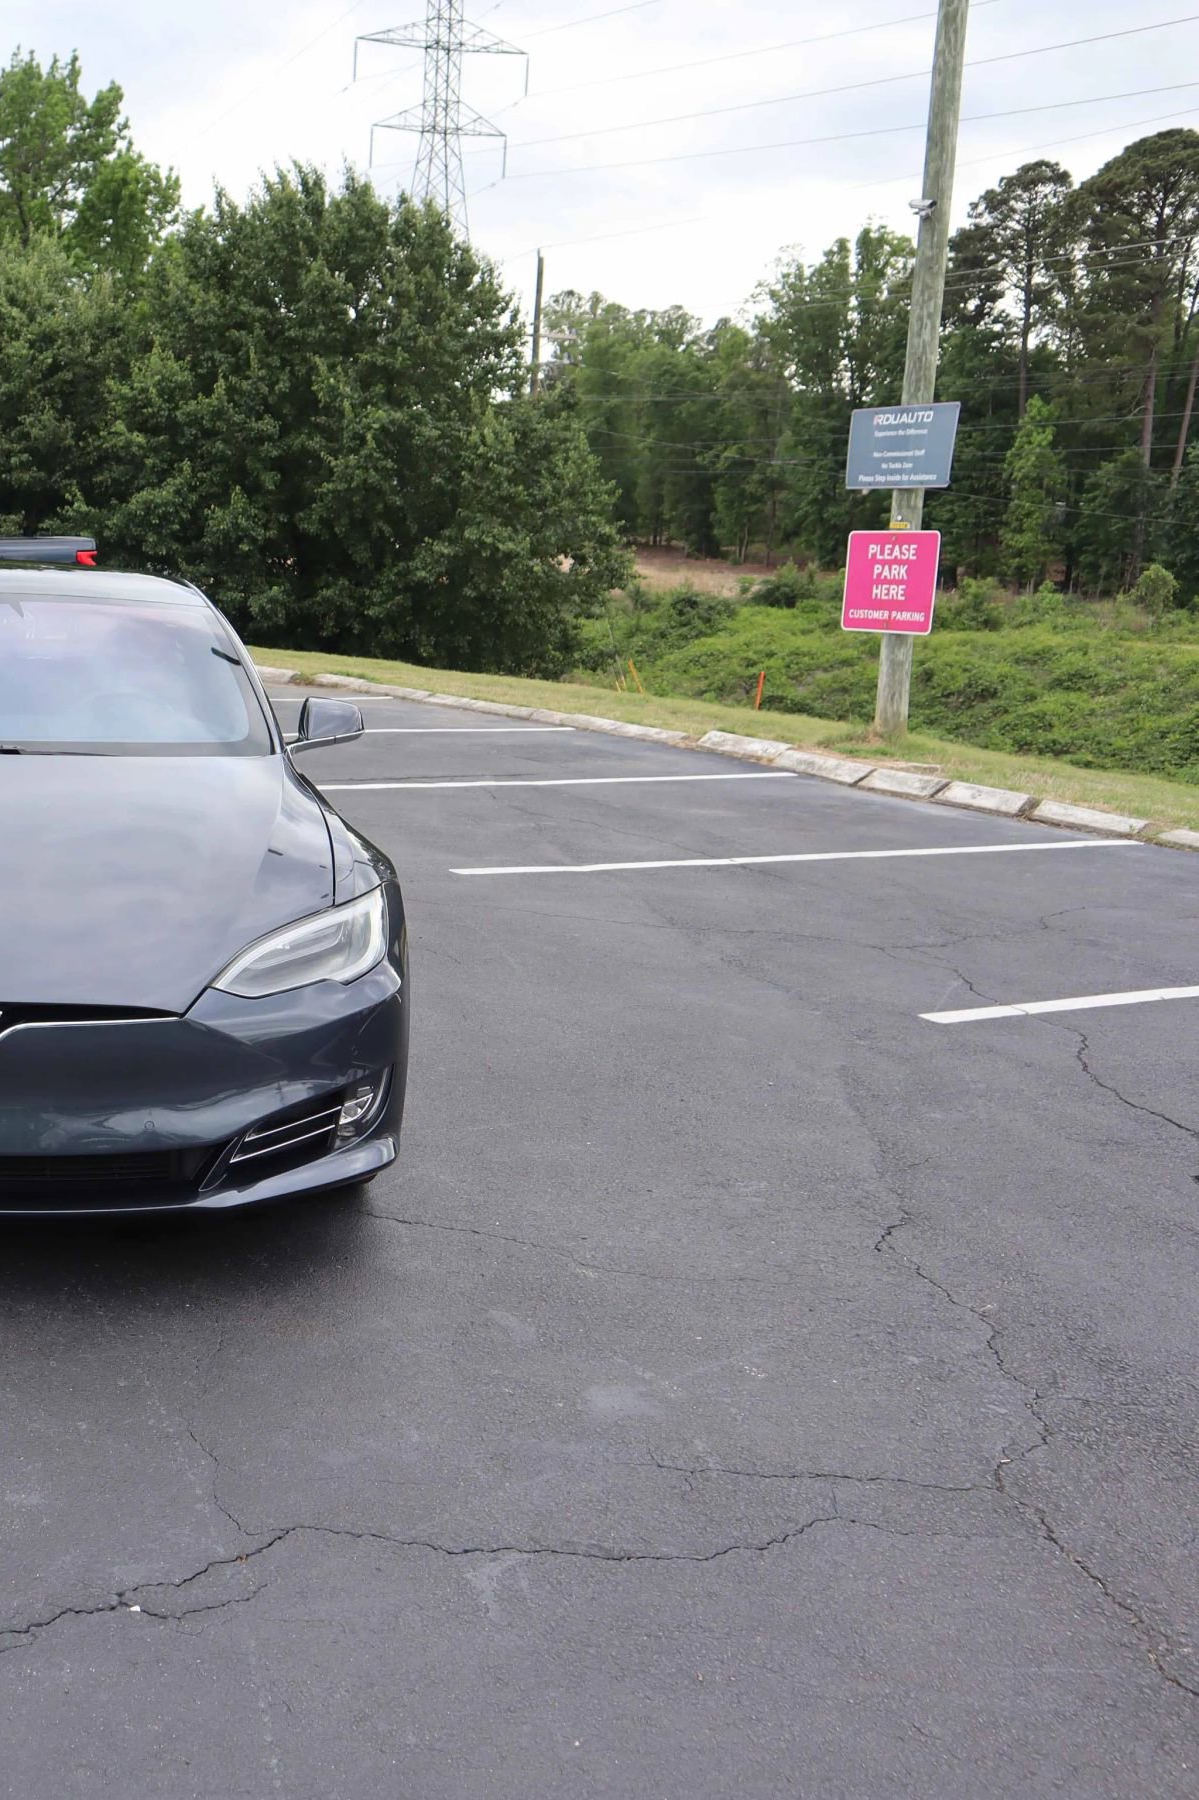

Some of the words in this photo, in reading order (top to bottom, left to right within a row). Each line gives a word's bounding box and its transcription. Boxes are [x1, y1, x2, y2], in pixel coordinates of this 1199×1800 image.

[868, 544, 917, 560] PLEASE
[873, 564, 909, 580] PARK
[871, 584, 907, 600] HERE
[849, 609, 889, 620] CUSTOMER
[890, 611, 925, 622] PARKING
